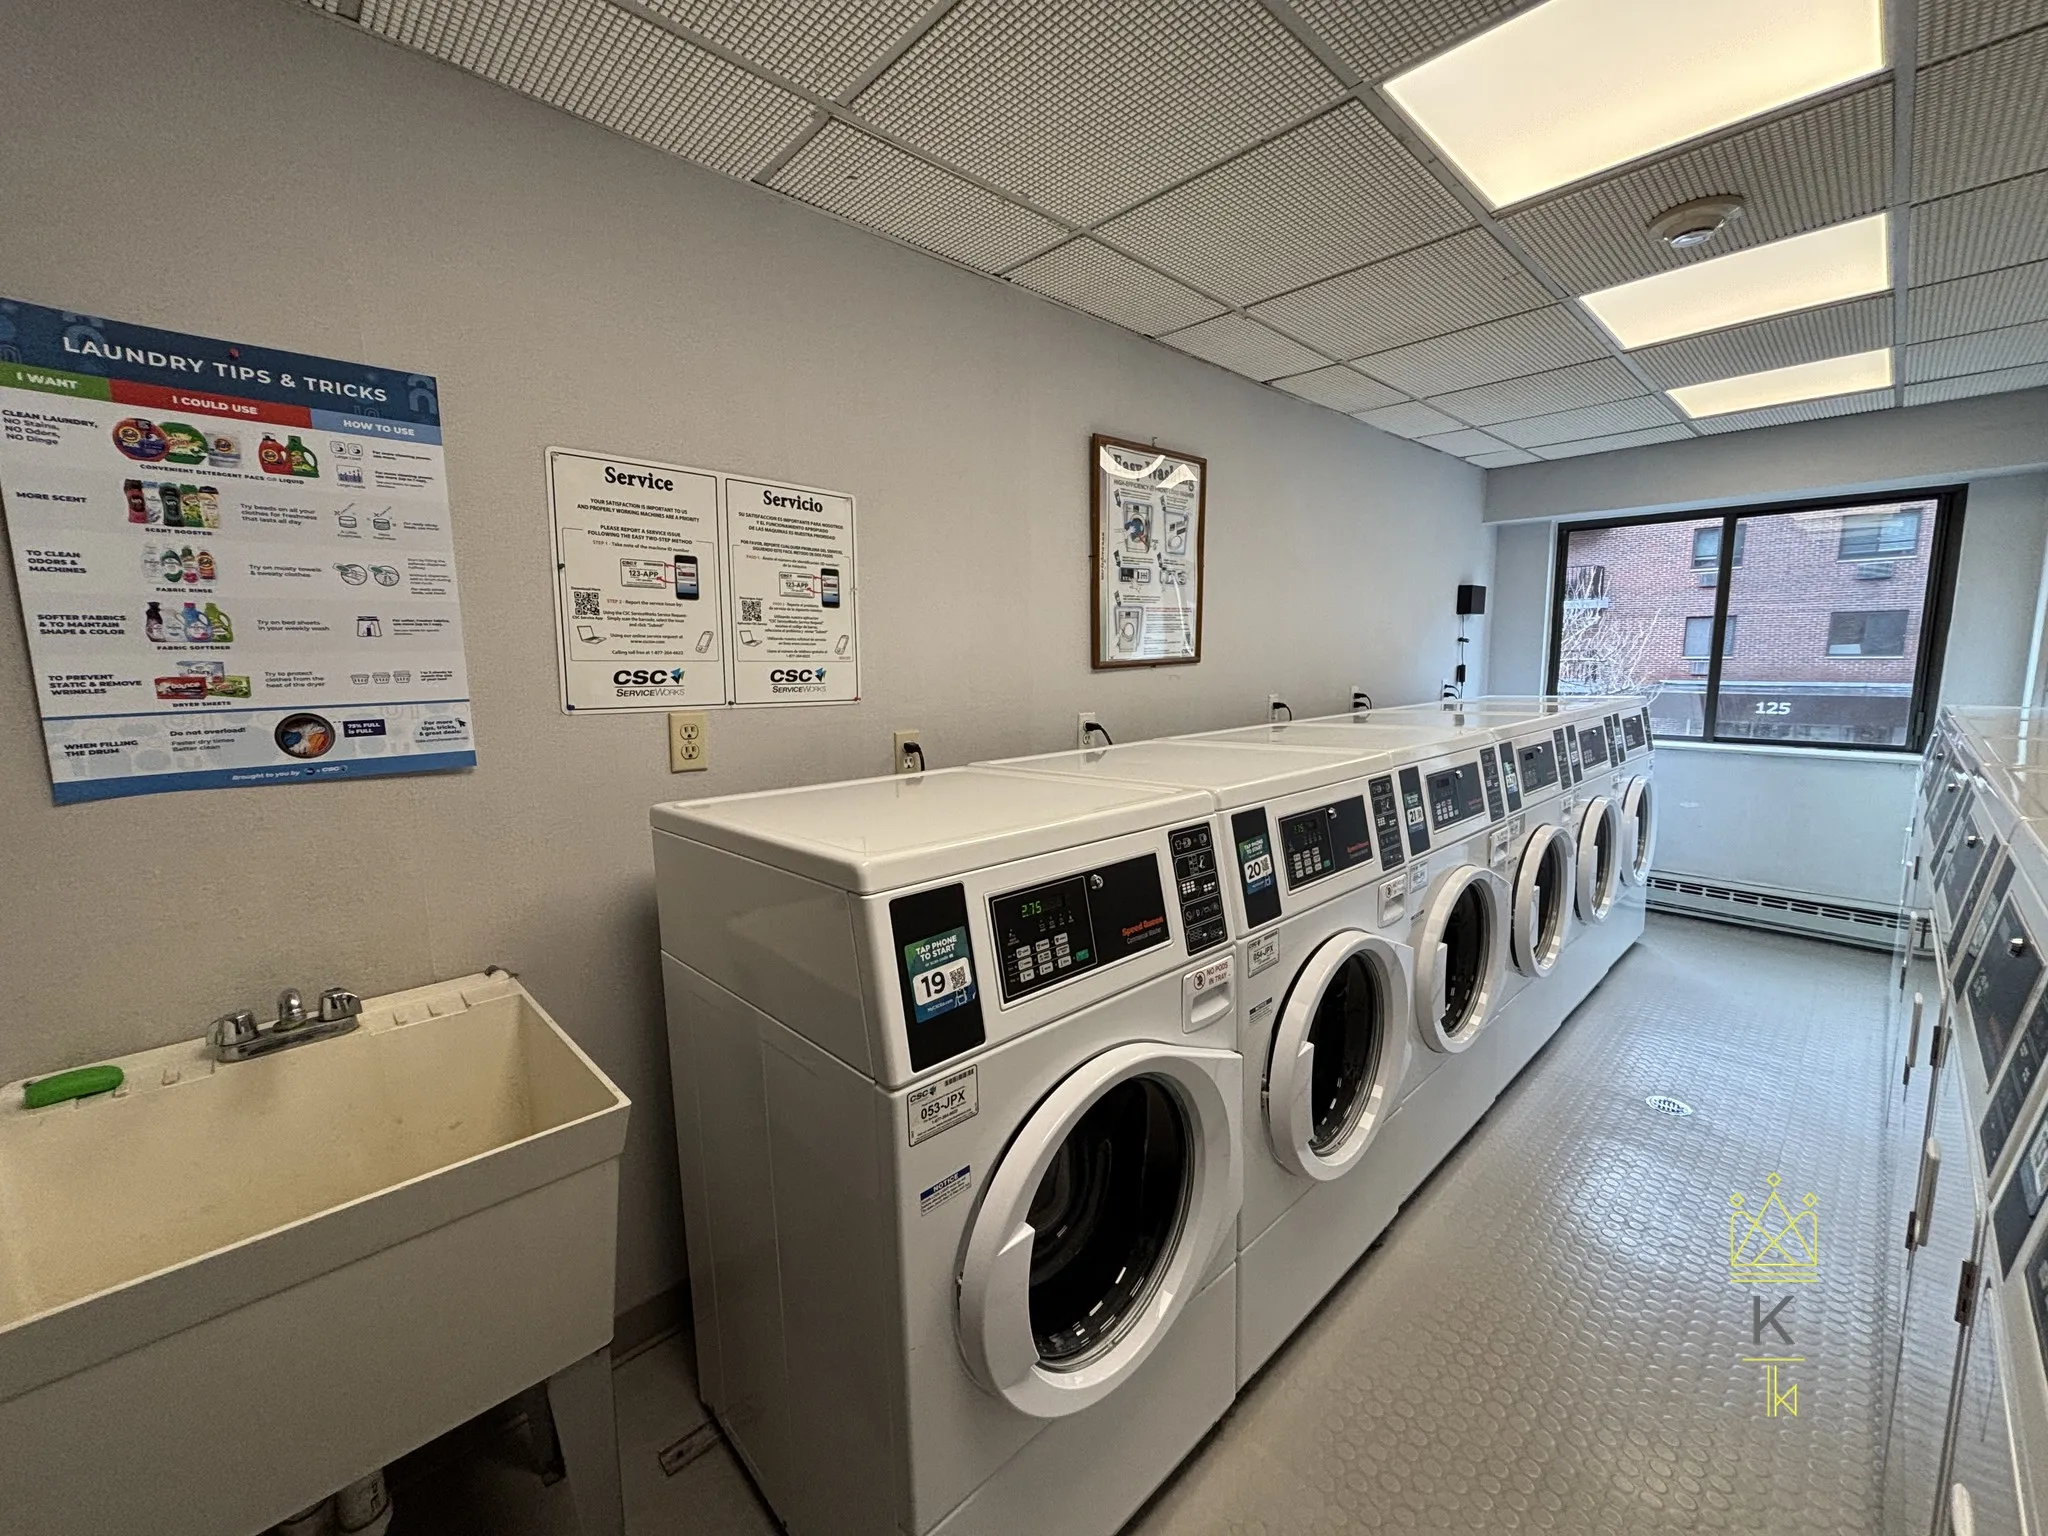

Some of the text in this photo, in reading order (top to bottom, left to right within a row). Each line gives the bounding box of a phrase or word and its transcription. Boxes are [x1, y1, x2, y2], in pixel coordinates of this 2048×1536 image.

[63, 336, 387, 402] LAUNDRY TIPS & TRICKS
[16, 372, 79, 389] I WANT
[172, 395, 258, 415] I COULD USE
[2, 410, 98, 428] CLEAN LAUNDRY,
[343, 419, 415, 437] HOW TO USE
[140, 465, 194, 474] CONVENIENT
[196, 470, 241, 479] DETERGENT
[605, 466, 674, 491] Service
[16, 492, 87, 503] MORE SCENT
[763, 490, 823, 513] Servicio
[590, 504, 615, 513] PROPERLY
[640, 511, 665, 519] MACHINES
[605, 499, 640, 509] SATISFACTION
[646, 505, 673, 513] IMPORTANT
[745, 512, 777, 521] SATISFACCION
[783, 518, 810, 526] IMPORTANTE
[766, 522, 804, 531] FUNCIONAMIENTO
[588, 530, 620, 538] FOLLOWING
[29, 566, 87, 574] MACHINES
[629, 570, 659, 578] 123-APP
[613, 669, 667, 685] CSC
[770, 669, 813, 683] CSC
[1755, 701, 1792, 715] 125
[185, 729, 201, 737] not
[204, 727, 246, 736] overload!
[99, 740, 139, 748] FILLING
[89, 748, 120, 756] DRUM
[232, 773, 265, 781] Brought
[1409, 811, 1417, 823] 21
[1247, 862, 1261, 880] 20
[1122, 922, 1143, 937] Speed
[915, 934, 958, 956] TAP PHONE
[920, 943, 956, 962] TO START
[1207, 961, 1228, 976] NO PODS
[920, 971, 946, 998] 19
[1208, 971, 1227, 985] IN TRAY
[910, 1089, 929, 1103] CSC
[920, 1090, 966, 1120] 053-JPX
[933, 1172, 959, 1193] NOTICE
